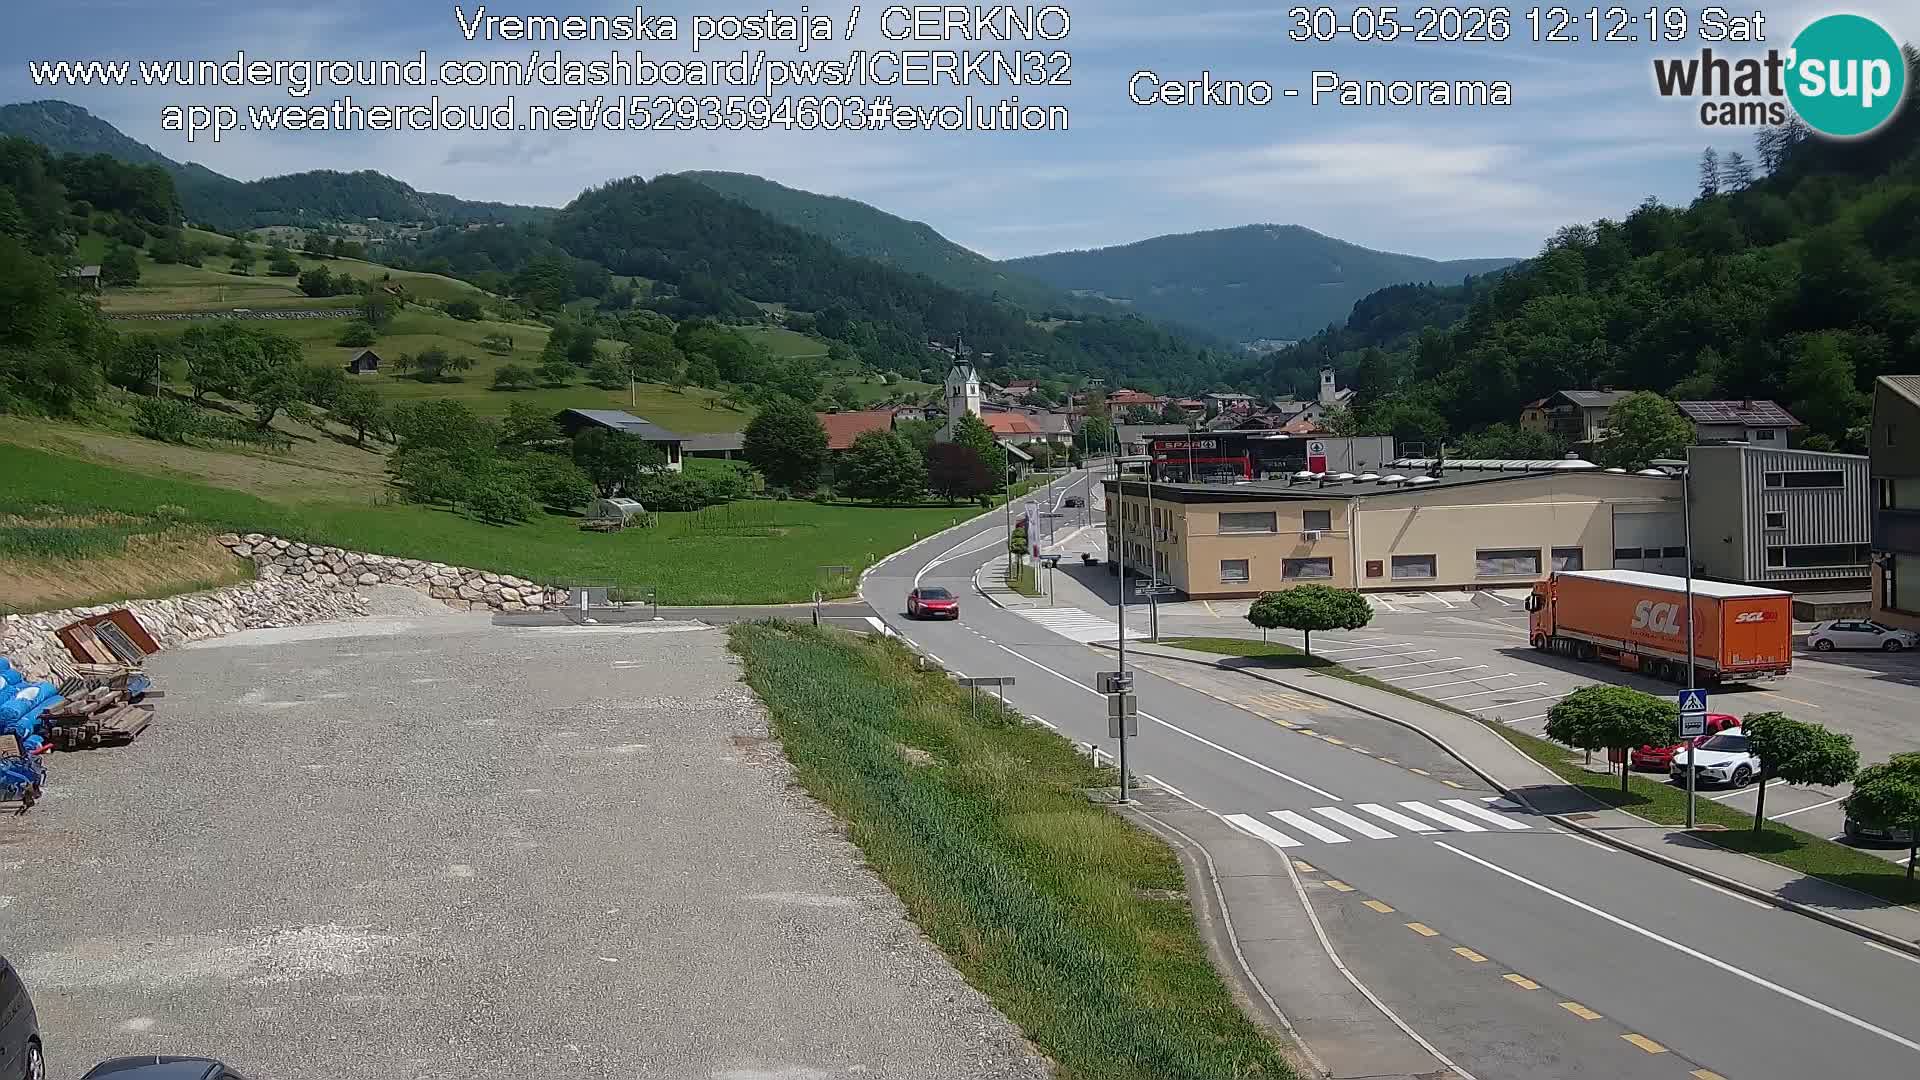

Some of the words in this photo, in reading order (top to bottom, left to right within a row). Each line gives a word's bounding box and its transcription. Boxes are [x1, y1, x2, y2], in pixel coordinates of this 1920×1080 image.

[1165, 441, 1201, 449] SPAR
[1632, 600, 1680, 634] SGL
[1735, 611, 1764, 623] SGL
